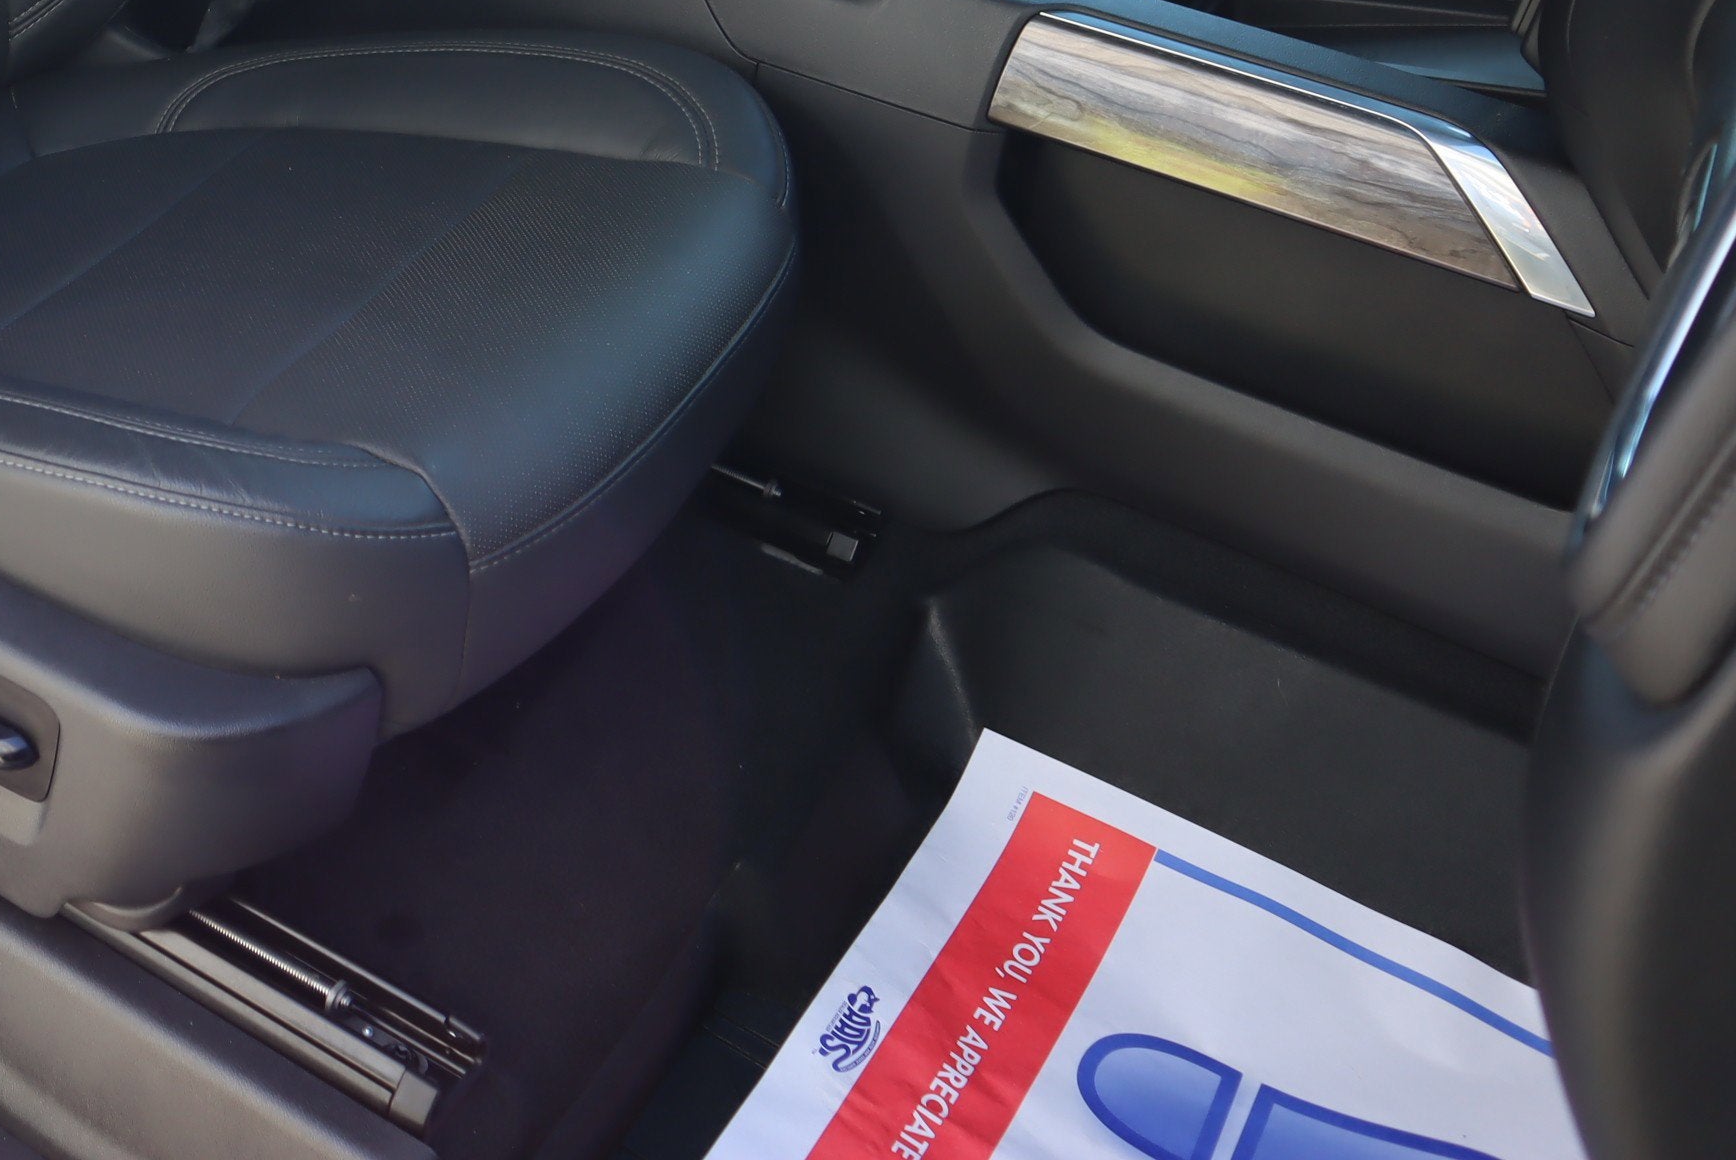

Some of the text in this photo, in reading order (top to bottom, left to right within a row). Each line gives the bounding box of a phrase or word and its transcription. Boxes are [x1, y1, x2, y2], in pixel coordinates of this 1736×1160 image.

[890, 838, 1101, 1160] THANK YOU, WE APPRECIATE
